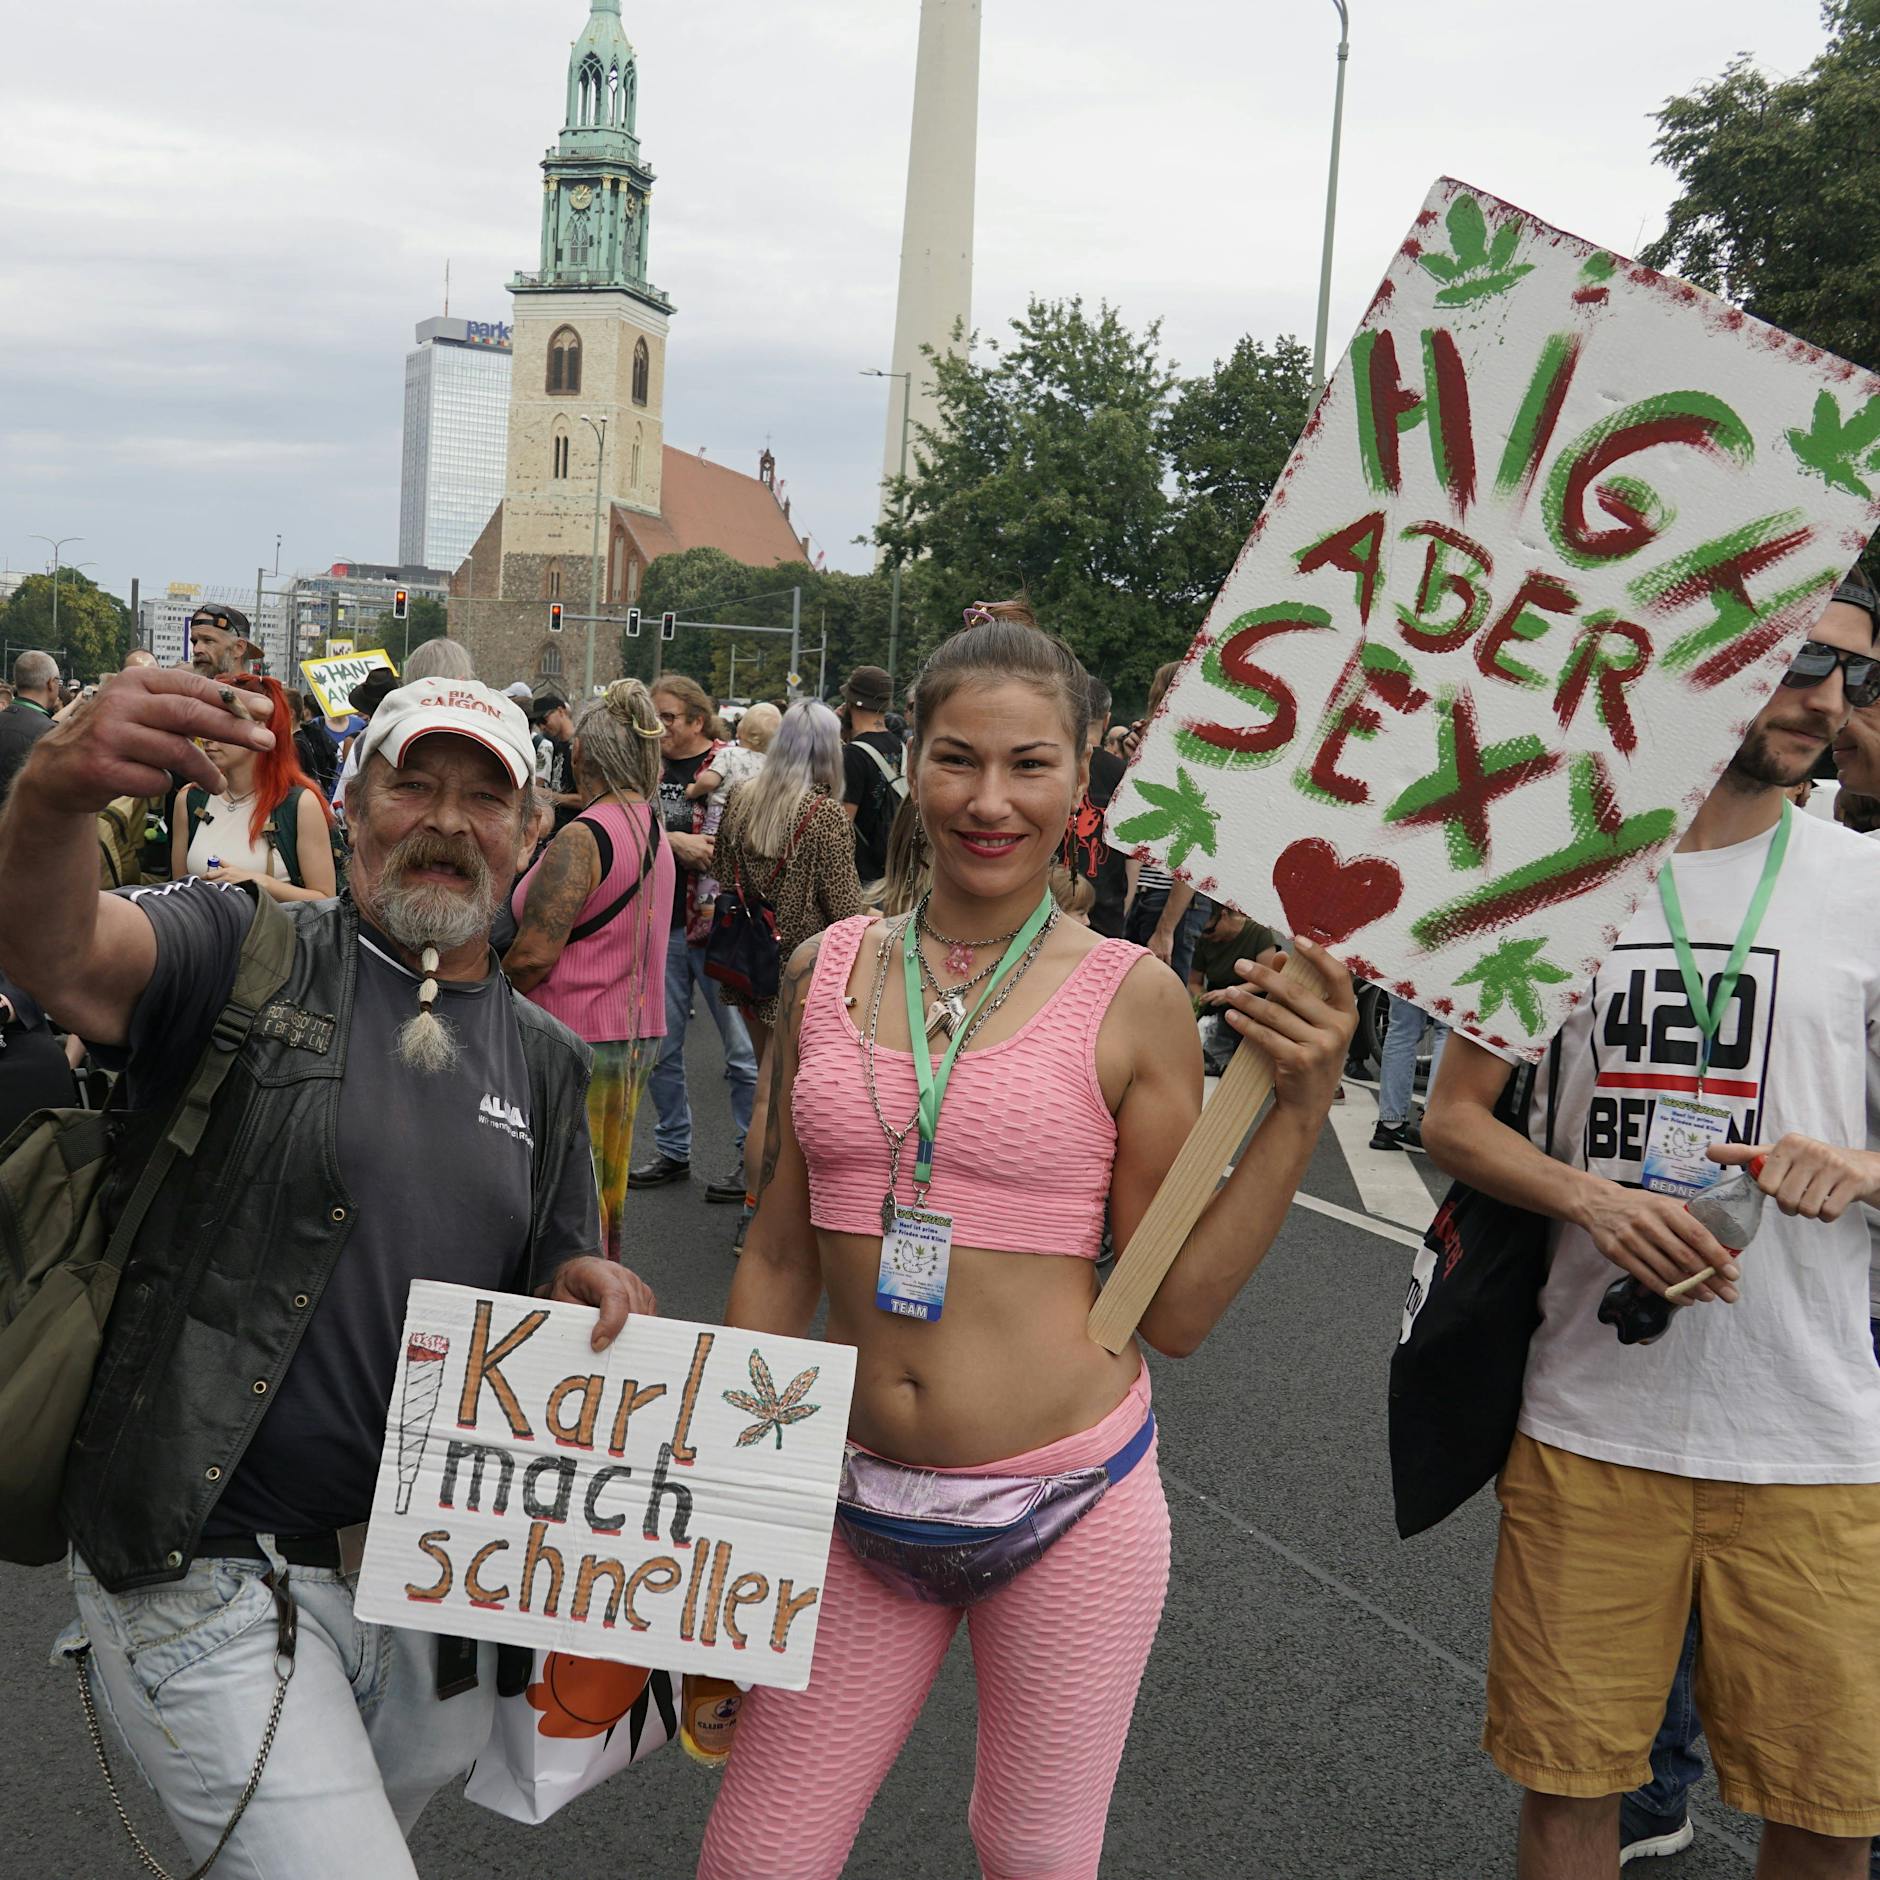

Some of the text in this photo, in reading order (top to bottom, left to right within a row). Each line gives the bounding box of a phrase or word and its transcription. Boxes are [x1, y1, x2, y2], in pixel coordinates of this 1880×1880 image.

[1350, 328, 1842, 692] HIGH
[1291, 509, 1656, 760] ABER
[419, 696, 502, 719] SAIGON
[449, 690, 474, 700] BIA
[1175, 602, 1678, 959] SEXY
[1604, 969, 1757, 1070] 420
[1588, 1097, 1755, 1171] BEN
[1649, 1178, 1697, 1198] REDNE
[890, 1298, 929, 1319] TEAM
[456, 1299, 715, 1464] Karl
[438, 1440, 693, 1548] mach
[404, 1521, 820, 1653] schneller
[697, 1718, 737, 1730] CLUB-M
